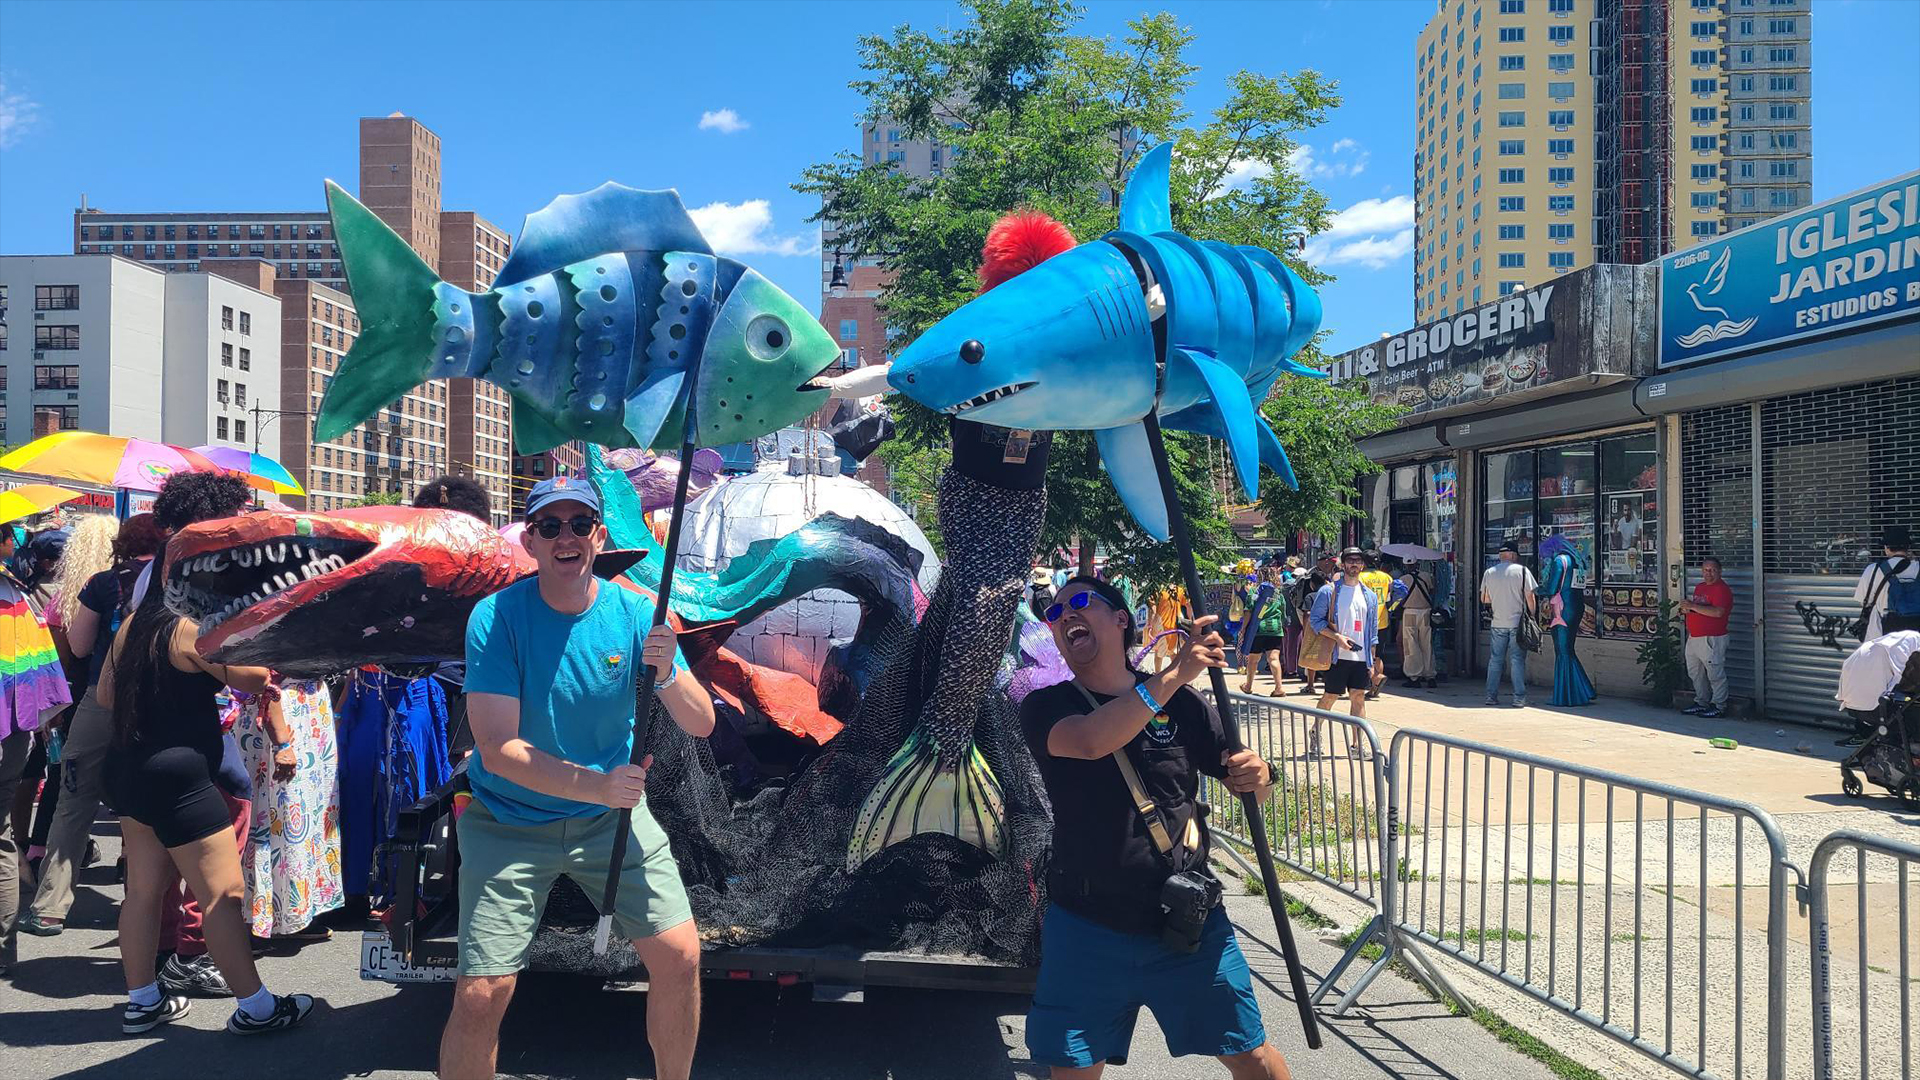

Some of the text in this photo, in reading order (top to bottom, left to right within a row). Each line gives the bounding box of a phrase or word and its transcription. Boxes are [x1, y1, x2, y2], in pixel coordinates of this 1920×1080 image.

[1776, 184, 1920, 265] IGLESI
[1796, 287, 1898, 328] ESTUDIOS
[1359, 348, 1379, 376] &
[1386, 285, 1554, 368] GROCERY
[1384, 371, 1399, 386] Cold
[1401, 367, 1418, 381] Beer
[1427, 359, 1444, 373] ATM
[1388, 806, 1398, 841] NYPD
[1818, 922, 1828, 952] Long
[369, 946, 389, 970] CE
[1820, 955, 1830, 993] Fence
